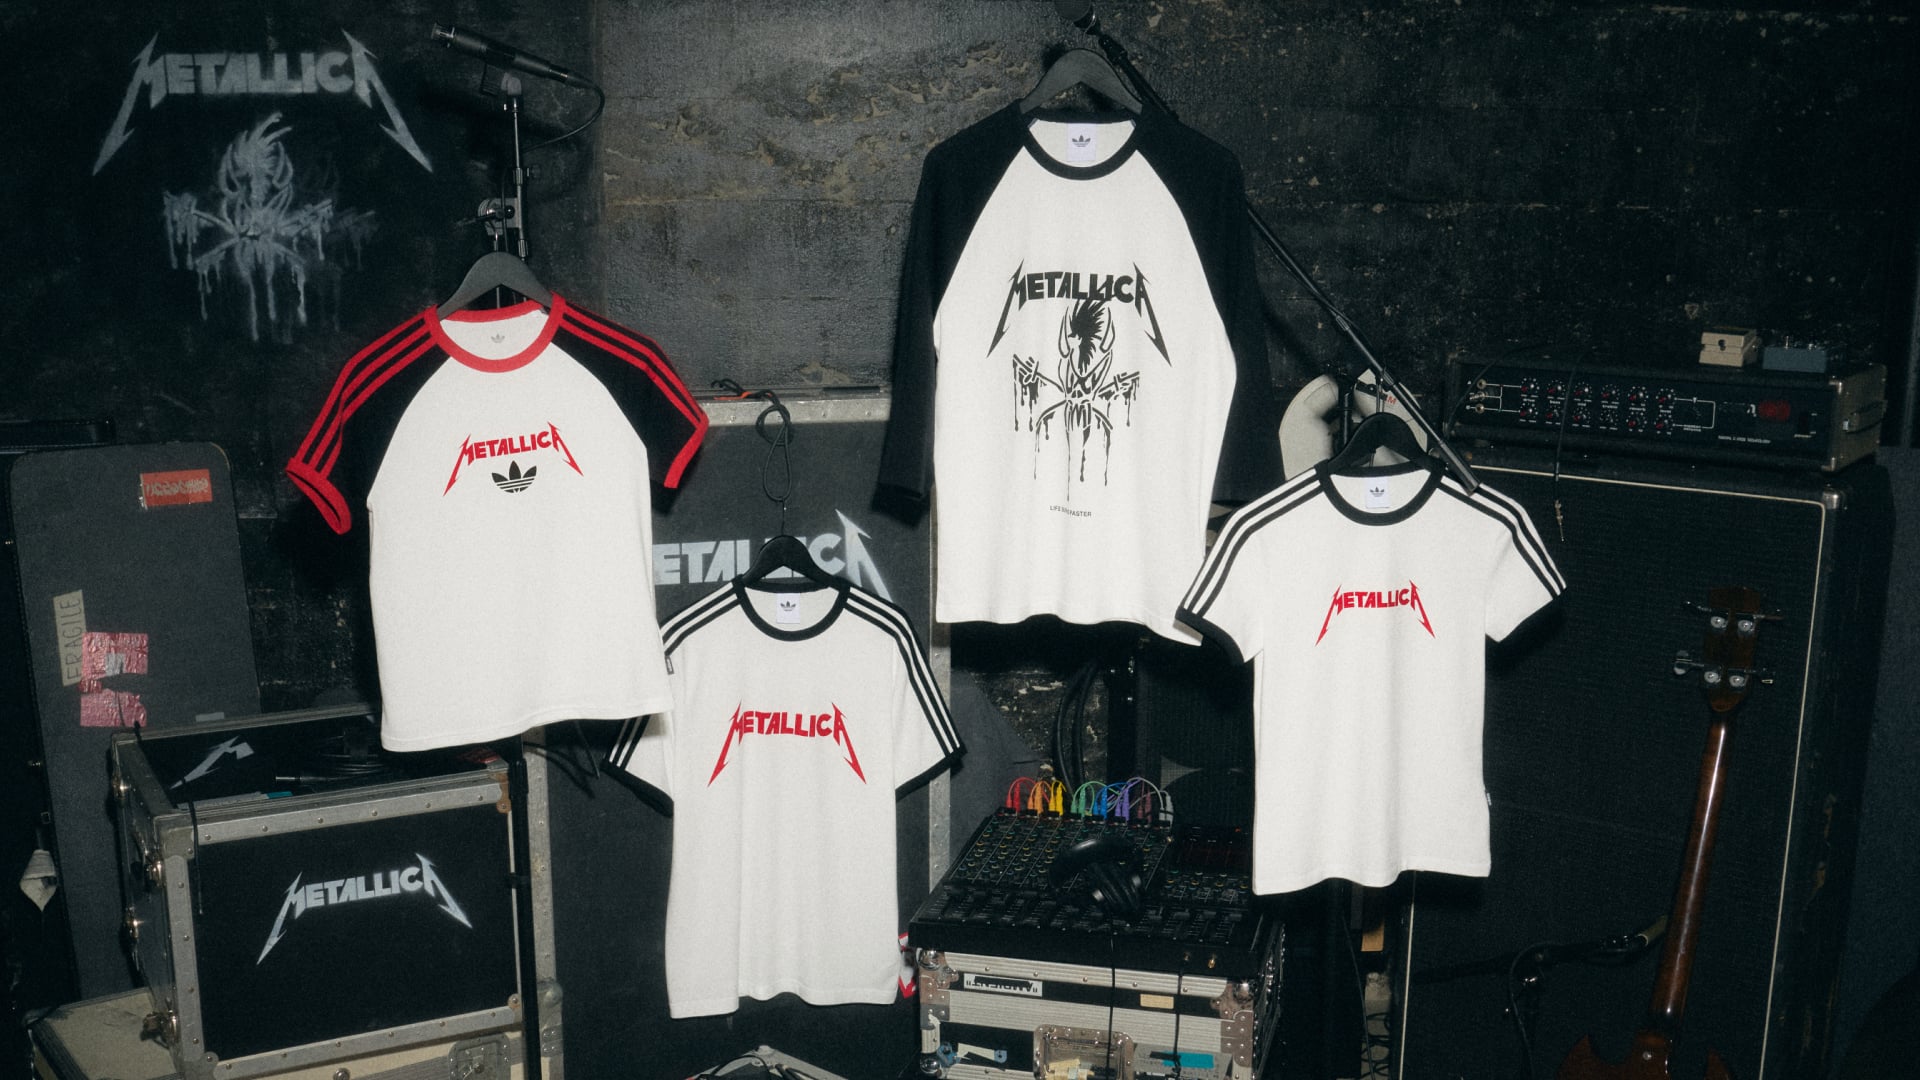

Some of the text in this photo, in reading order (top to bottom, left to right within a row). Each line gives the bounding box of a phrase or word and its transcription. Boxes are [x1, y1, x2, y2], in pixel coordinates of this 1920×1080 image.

[93, 28, 433, 176] METALLICA
[987, 258, 1172, 367] METALLICA
[443, 420, 584, 497] METALLICA
[59, 599, 82, 679] FRAGILE
[1315, 579, 1436, 647] METALLICA
[707, 700, 867, 788] METALLICA
[256, 852, 473, 966] METALLICA
